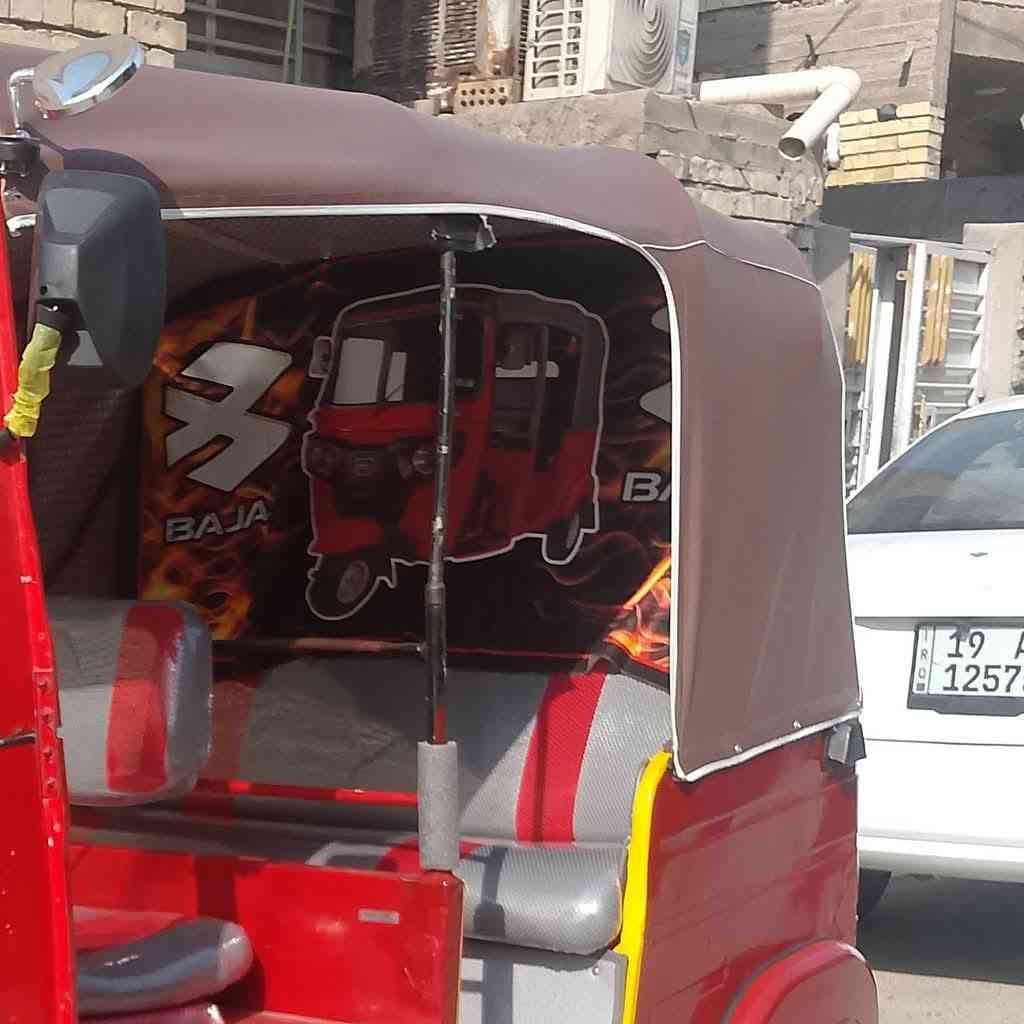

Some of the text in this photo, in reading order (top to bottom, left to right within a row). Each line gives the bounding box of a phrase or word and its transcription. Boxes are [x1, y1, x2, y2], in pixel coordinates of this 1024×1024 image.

[166, 499, 269, 543] BAJA
[946, 630, 986, 660] 19
[942, 663, 1024, 694] 1257
